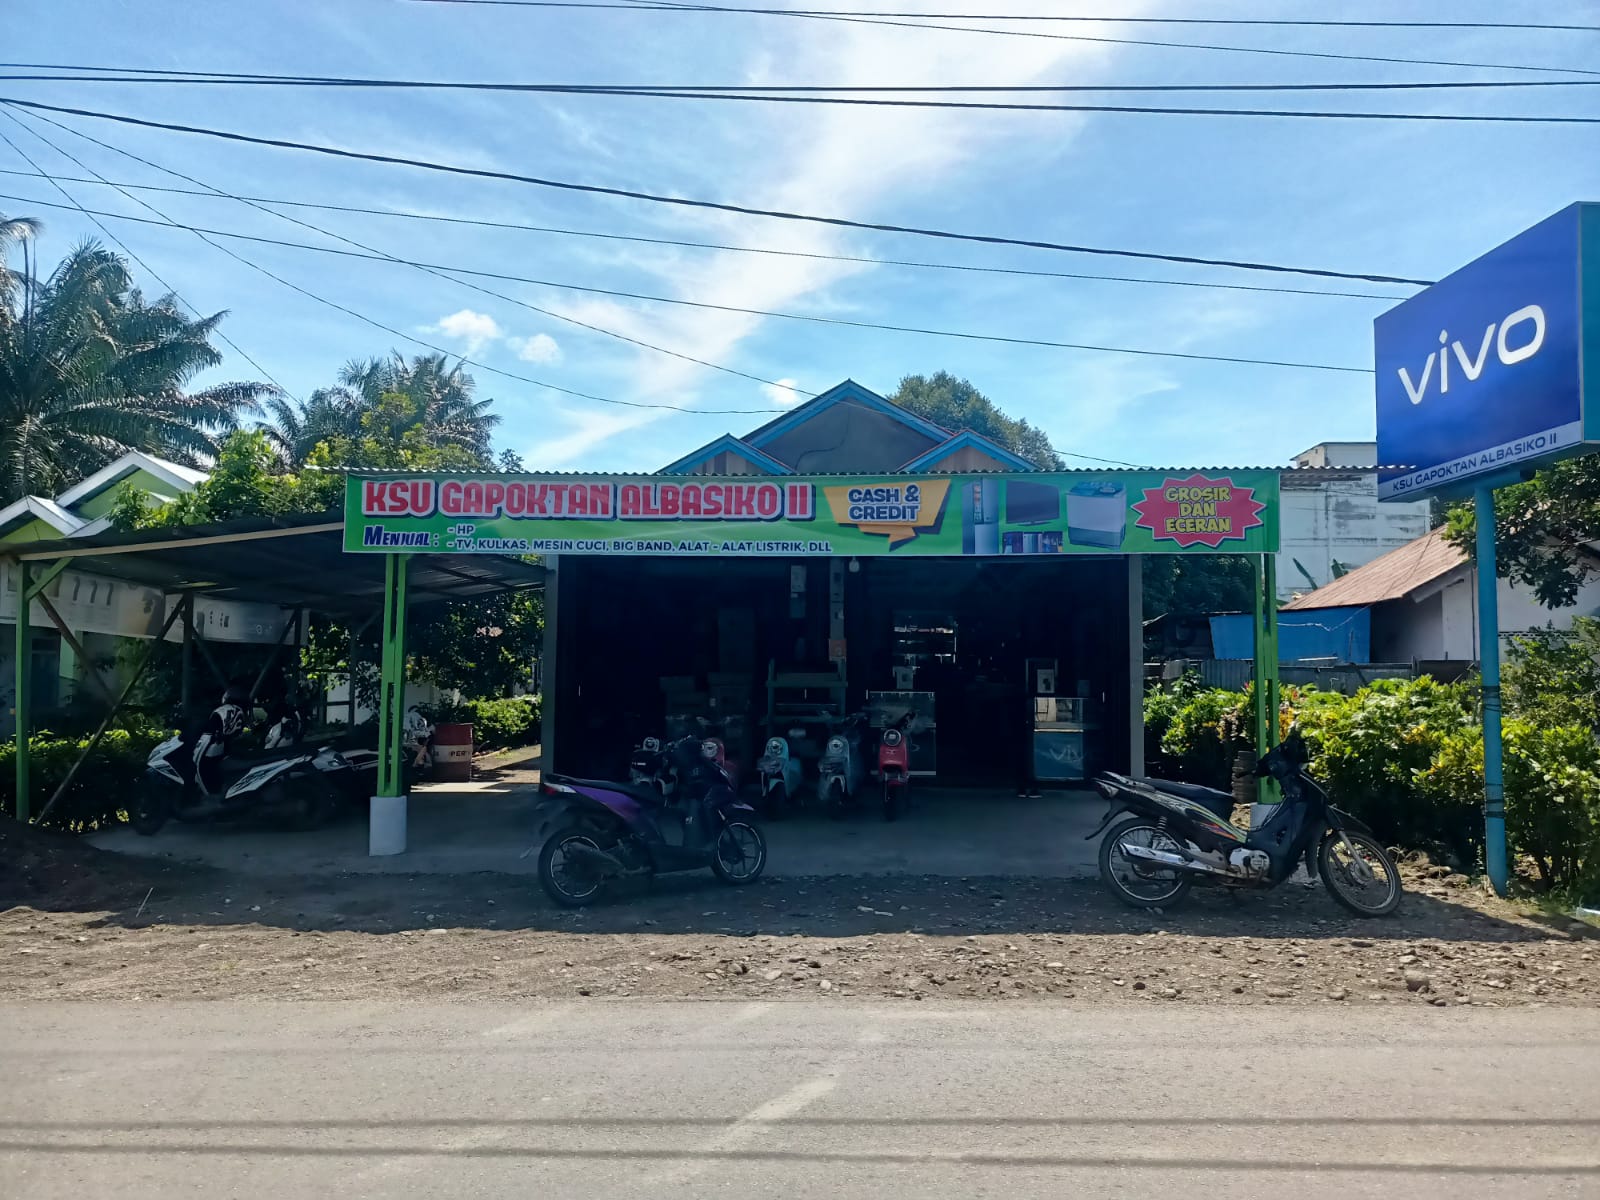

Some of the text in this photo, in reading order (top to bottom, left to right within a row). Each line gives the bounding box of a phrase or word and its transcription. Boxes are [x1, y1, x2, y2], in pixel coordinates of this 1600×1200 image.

[1398, 304, 1546, 405] vivo
[1392, 432, 1557, 492] KSU GAPOKTAN ALBASIKO II
[365, 481, 809, 517] KSU GAPOKTAN ALBASIKO II
[848, 485, 921, 503] CASH &
[1165, 486, 1232, 502] GROSIR
[848, 504, 920, 522] CREDIT
[1179, 502, 1217, 517] DAN
[1165, 517, 1232, 533] ECERAN
[478, 540, 529, 551] KULKAS,
[533, 541, 573, 551] MESIN
[576, 541, 610, 552] CUCI,
[613, 541, 634, 551] BIG
[637, 541, 675, 552] BAND,
[679, 541, 710, 552] ALAT
[722, 542, 753, 552] ALAT
[756, 542, 806, 553] LISTRIK,
[809, 542, 831, 552] DLL
